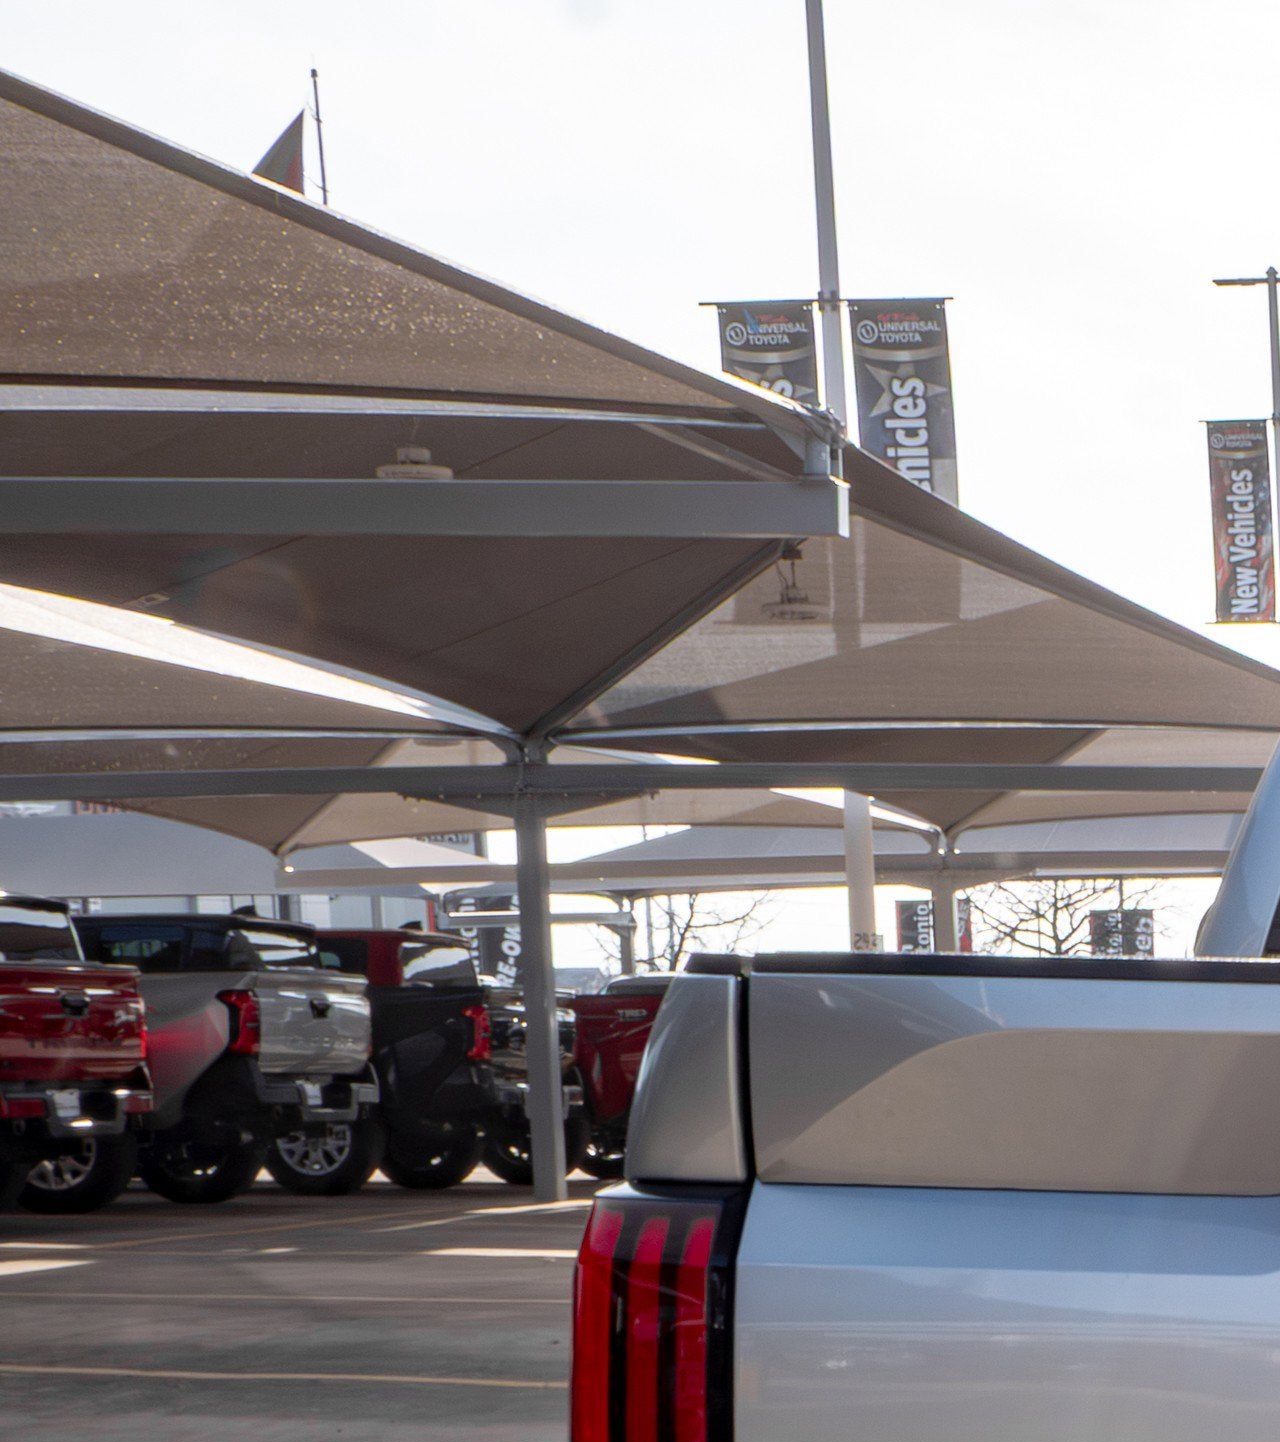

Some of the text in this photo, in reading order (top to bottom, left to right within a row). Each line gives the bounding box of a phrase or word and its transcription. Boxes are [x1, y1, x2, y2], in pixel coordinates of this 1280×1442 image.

[878, 321, 941, 332] UNIVERSAL
[748, 334, 790, 345] TOYOTA
[880, 332, 922, 343] TOYOTA
[1226, 468, 1257, 562] Vehicles
[1231, 564, 1258, 614] New
